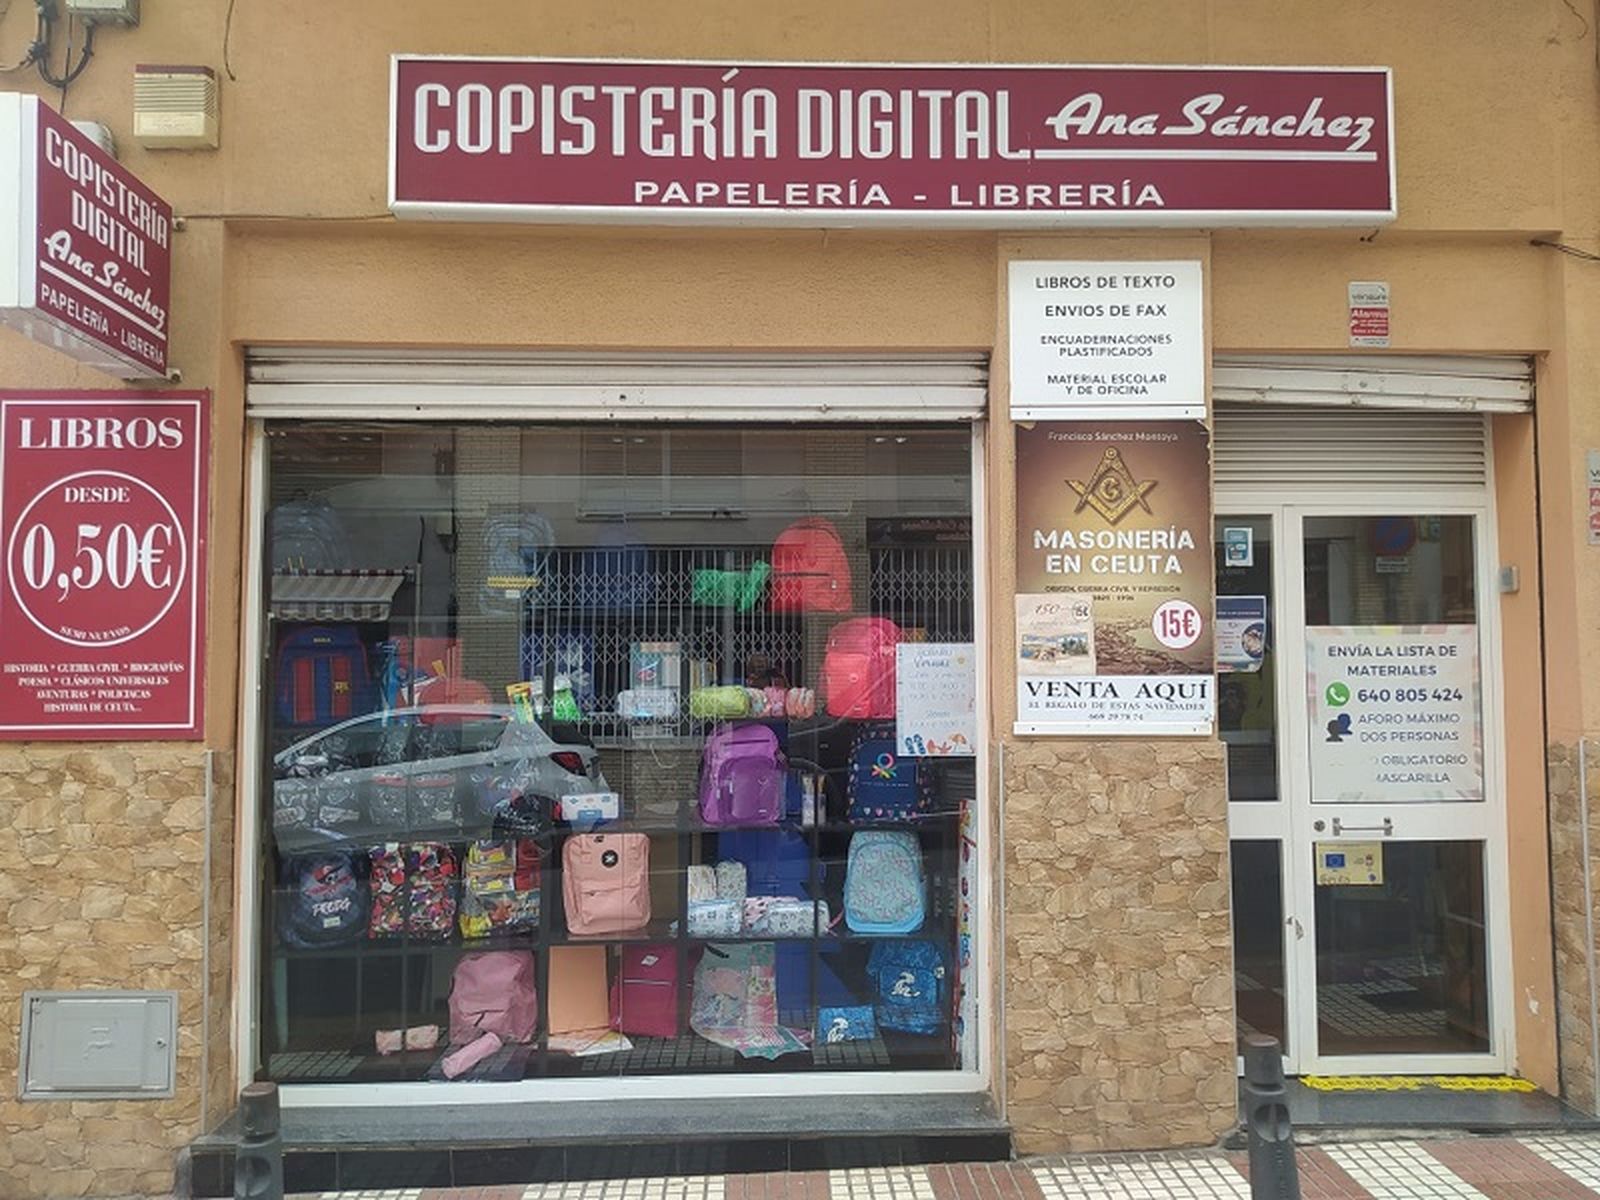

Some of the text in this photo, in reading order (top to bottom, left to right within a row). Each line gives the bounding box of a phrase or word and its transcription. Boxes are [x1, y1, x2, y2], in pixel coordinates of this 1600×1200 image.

[414, 67, 1376, 161] COPISTERÍA DIGITAL Ana Sánchez
[45, 127, 168, 249] COPISTERÍA
[634, 179, 891, 205] PAPELERÍA
[951, 179, 1165, 206] LIBRERÍA
[71, 190, 150, 276] DIGITAL
[44, 229, 166, 333] Ana Sánchez
[1035, 275, 1176, 289] LIBROS DE TEXTO
[1045, 304, 1168, 317] ENVIOS DE FAX
[41, 283, 110, 336] PAPELERÍA
[121, 328, 165, 365] LIBRERÍA
[1040, 334, 1173, 345] ENCUADERNACIONES
[1059, 346, 1153, 357] PLASTIFICADOS
[1047, 373, 1167, 385] MATERIAL ESCOLAR
[1065, 385, 1149, 395] Y DE OFICINA
[18, 417, 183, 449] LIBROS
[64, 487, 130, 503] DESDE
[1033, 525, 1195, 550] MASONERÍA
[22, 523, 173, 602] 0,50€
[1045, 554, 1182, 574] EN CEUTA
[1159, 609, 1196, 639] 15€
[1328, 643, 1457, 657] ENVÍA LA LISTA DE
[3, 663, 49, 673] HISTORIA
[57, 663, 95, 672] GUERRA
[96, 662, 121, 672] CIVIL
[1347, 665, 1437, 677] MATERIALES
[106, 675, 170, 685] UNIVERSALES
[1026, 679, 1208, 702] VENTA AQUÍ
[1357, 688, 1463, 701] 640 805 424
[43, 702, 89, 712] HISTORIA
[1045, 701, 1087, 709] REGALO
[1110, 701, 1141, 710] ESTAS
[1358, 711, 1460, 724] AFORO MÁXIMO
[1360, 731, 1459, 742] DOS PERSONAS
[1381, 754, 1468, 765] OBLIGATORIO
